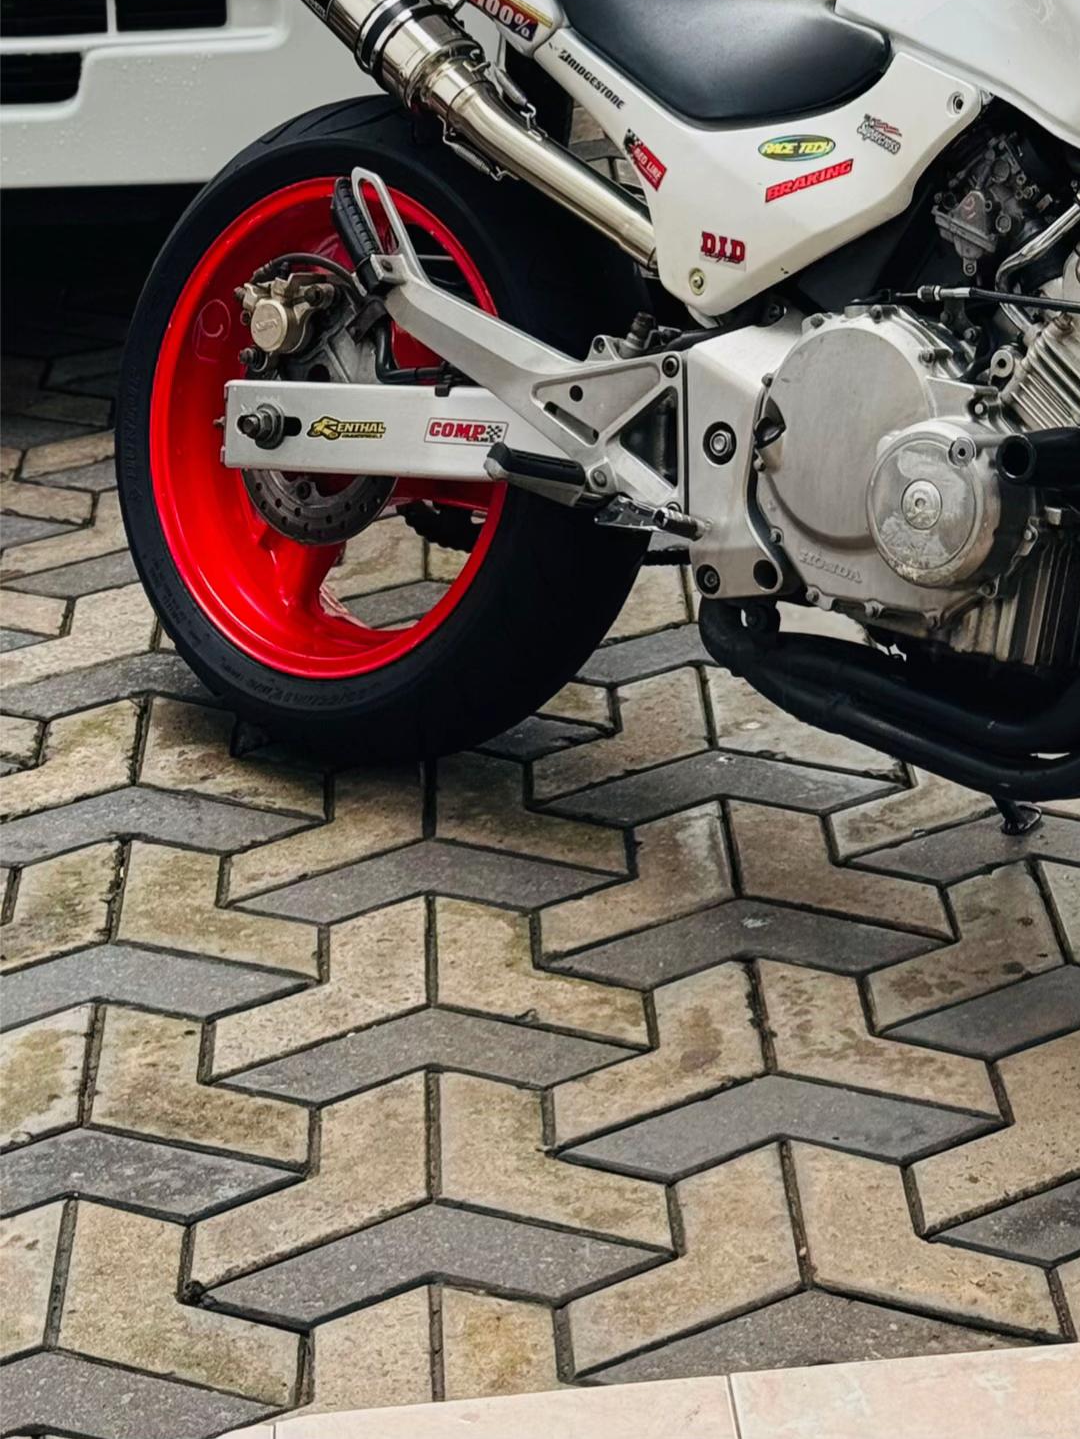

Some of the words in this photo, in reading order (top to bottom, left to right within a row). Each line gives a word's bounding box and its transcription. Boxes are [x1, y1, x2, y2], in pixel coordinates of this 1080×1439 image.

[557, 49, 626, 110] BRIDGESTONE
[767, 161, 851, 201] BRAKING
[429, 421, 486, 439] COMP
[799, 551, 864, 584] HONDA
